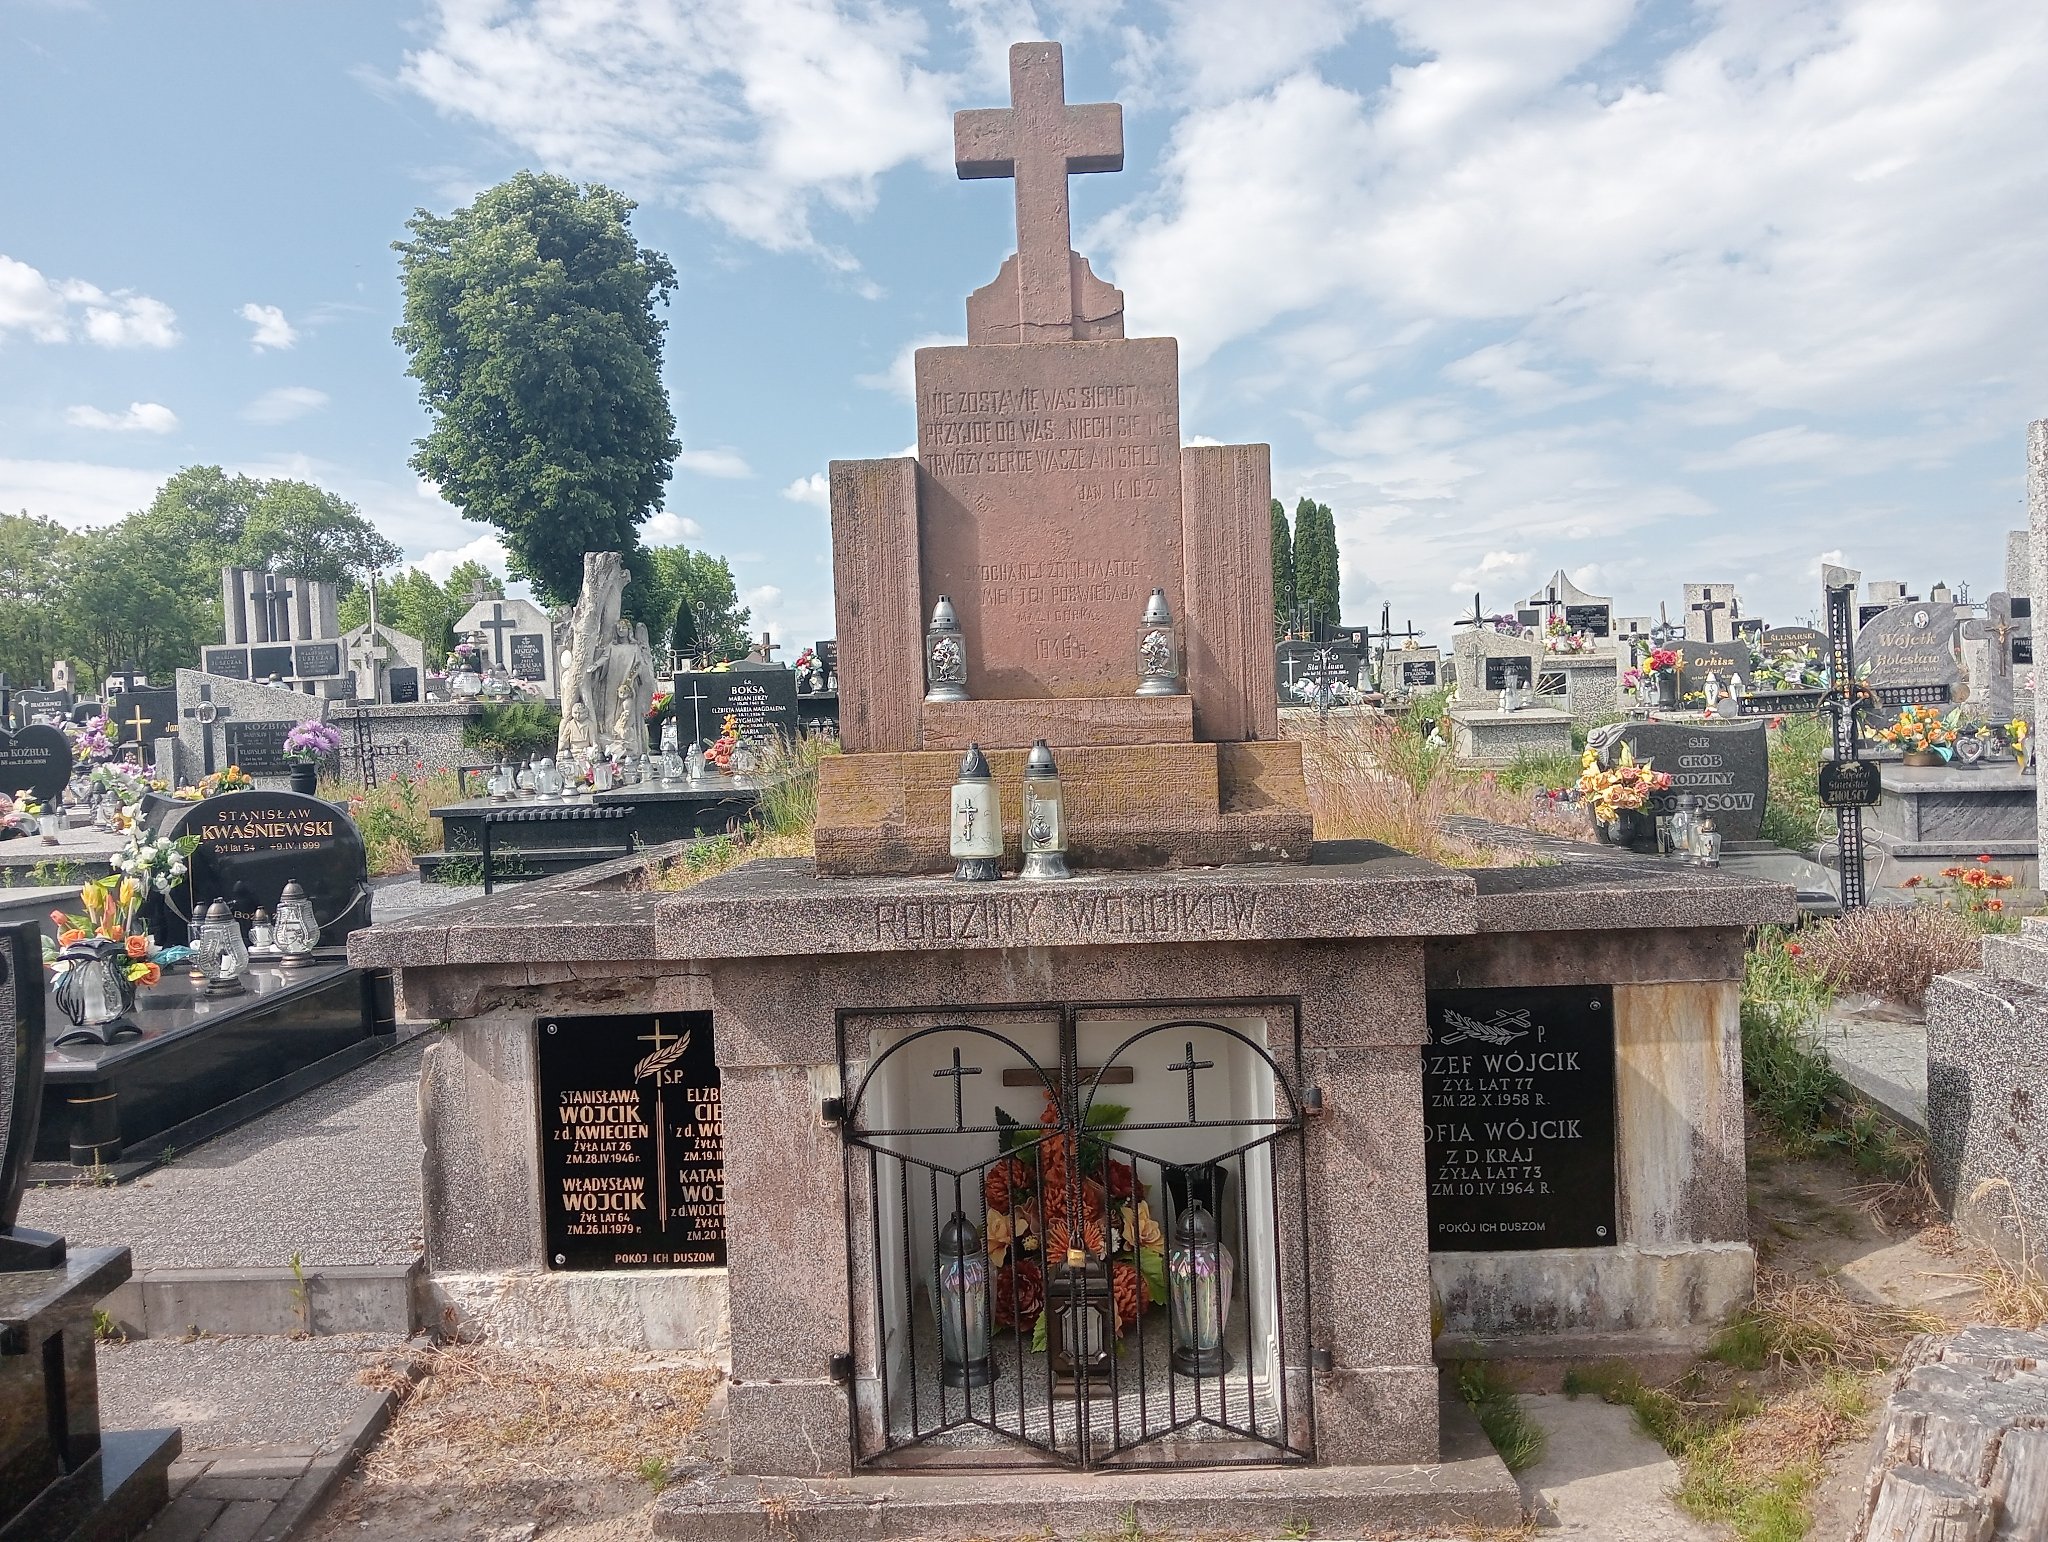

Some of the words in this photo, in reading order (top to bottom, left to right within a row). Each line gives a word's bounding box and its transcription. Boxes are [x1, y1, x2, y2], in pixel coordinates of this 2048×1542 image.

[1042, 387, 1077, 411] WAS
[1068, 415, 1112, 440] NIECH
[1036, 446, 1086, 471] WASZE
[1879, 631, 1937, 649] Wójcik
[1694, 657, 1735, 667] Orkisz
[731, 686, 765, 695] BOKSA
[1678, 754, 1723, 768] GRÓB
[1670, 772, 1735, 787] RODZINY
[219, 809, 311, 822] STANISŁAW
[202, 819, 333, 840] KWAŚNIEWSKI
[876, 897, 1041, 941] RODZINY
[1482, 1050, 1581, 1073] WÓJCIK
[1443, 1077, 1474, 1091] ŻYŁ
[1479, 1079, 1510, 1091] LAT
[1515, 1078, 1534, 1089] 77
[560, 1089, 640, 1104] STANISŁAWA
[559, 1104, 642, 1124] WÓJCIK
[575, 1123, 649, 1140] KWIECIEŃ
[1484, 1118, 1582, 1141] WÓJCIK
[573, 1140, 599, 1152] ŻYŁA
[600, 1142, 617, 1152] LAT
[619, 1141, 632, 1151] 26
[694, 1137, 718, 1149] ŻYŁA
[1439, 1165, 1482, 1180] ŻYŁA
[1487, 1167, 1518, 1179] LAT
[1523, 1166, 1542, 1179] 73
[562, 1177, 644, 1192] WŁADYSŁAW
[562, 1191, 647, 1211] WÓJCIK
[580, 1211, 597, 1223] ŻYŁ
[600, 1213, 616, 1222] LAT
[618, 1212, 630, 1222] 64
[694, 1217, 719, 1229] ŻYŁA
[1439, 1222, 1476, 1233] POKÓJ
[1479, 1223, 1497, 1232] ICH
[1500, 1222, 1546, 1232] DUSZOM
[615, 1252, 648, 1263] POKÓJ
[653, 1253, 669, 1263] ICH
[673, 1252, 715, 1263] DUSZOM
